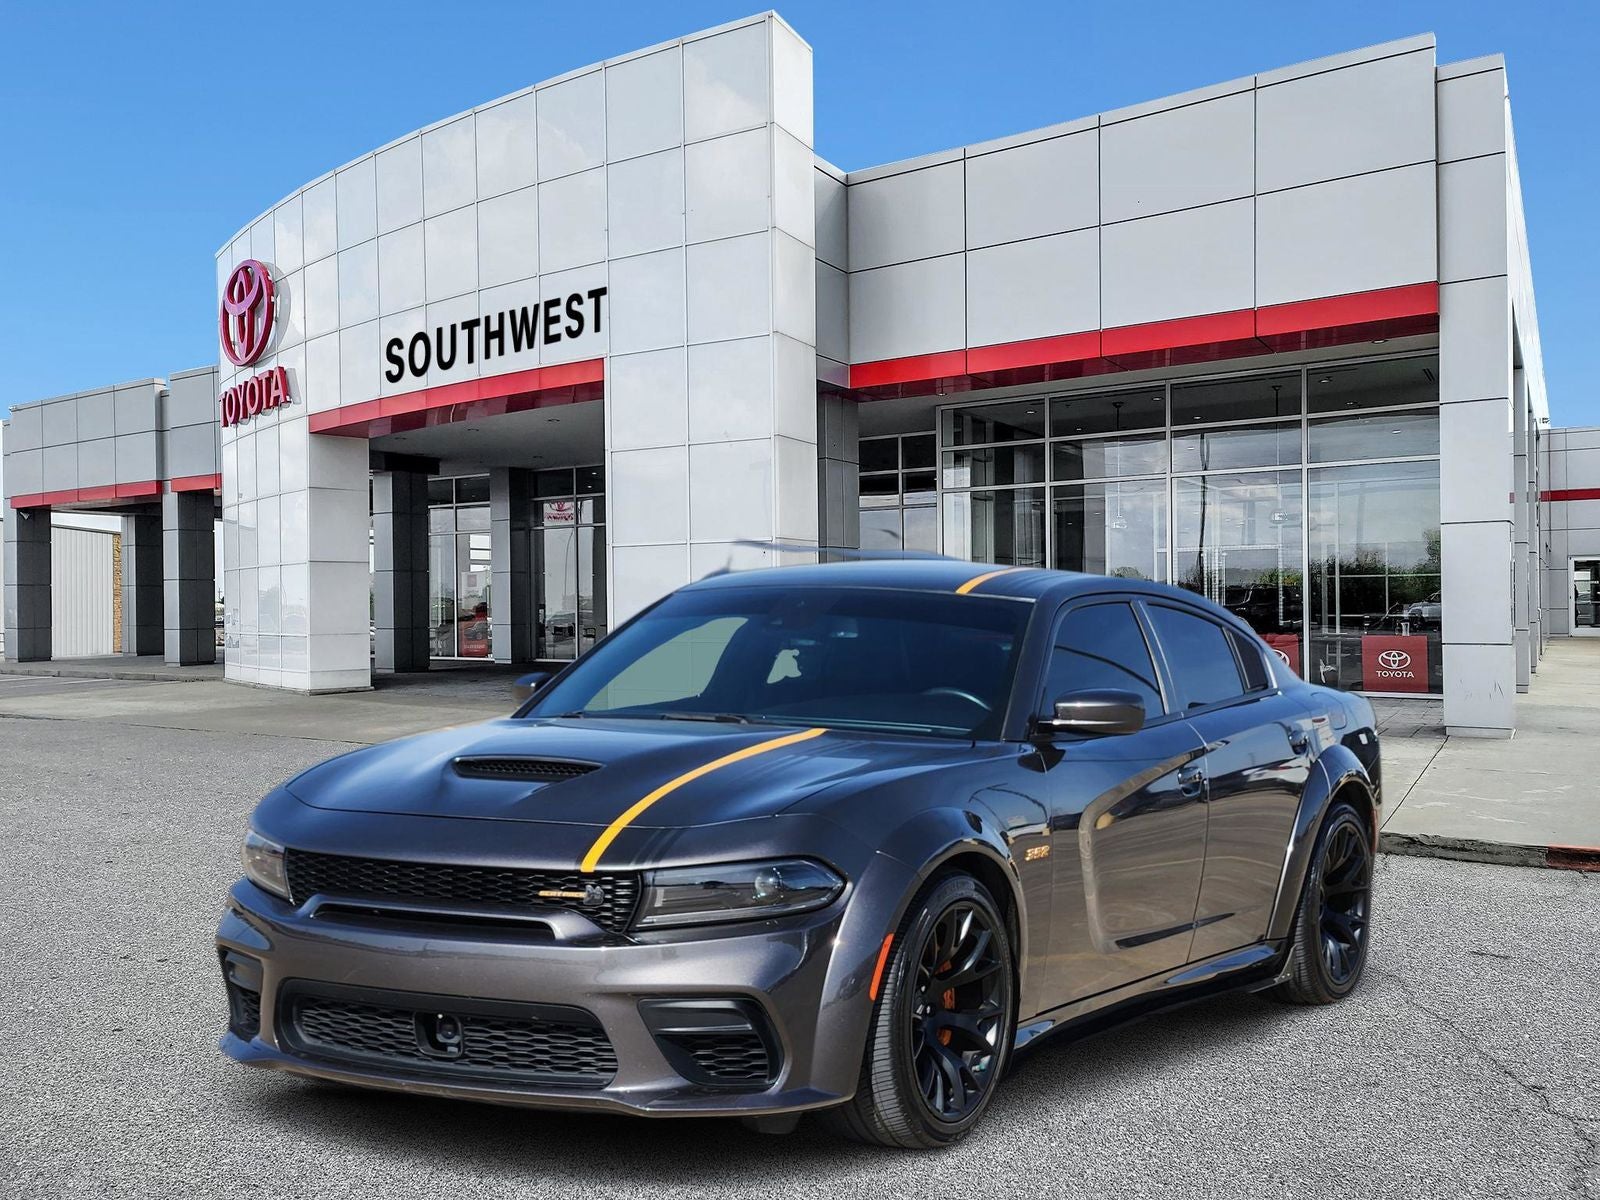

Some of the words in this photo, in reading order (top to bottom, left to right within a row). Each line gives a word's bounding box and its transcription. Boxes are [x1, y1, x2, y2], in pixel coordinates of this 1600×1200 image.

[385, 286, 608, 384] SOUTHWEST
[218, 366, 291, 428] TOYOTA
[1375, 670, 1415, 678] TOYOTA
